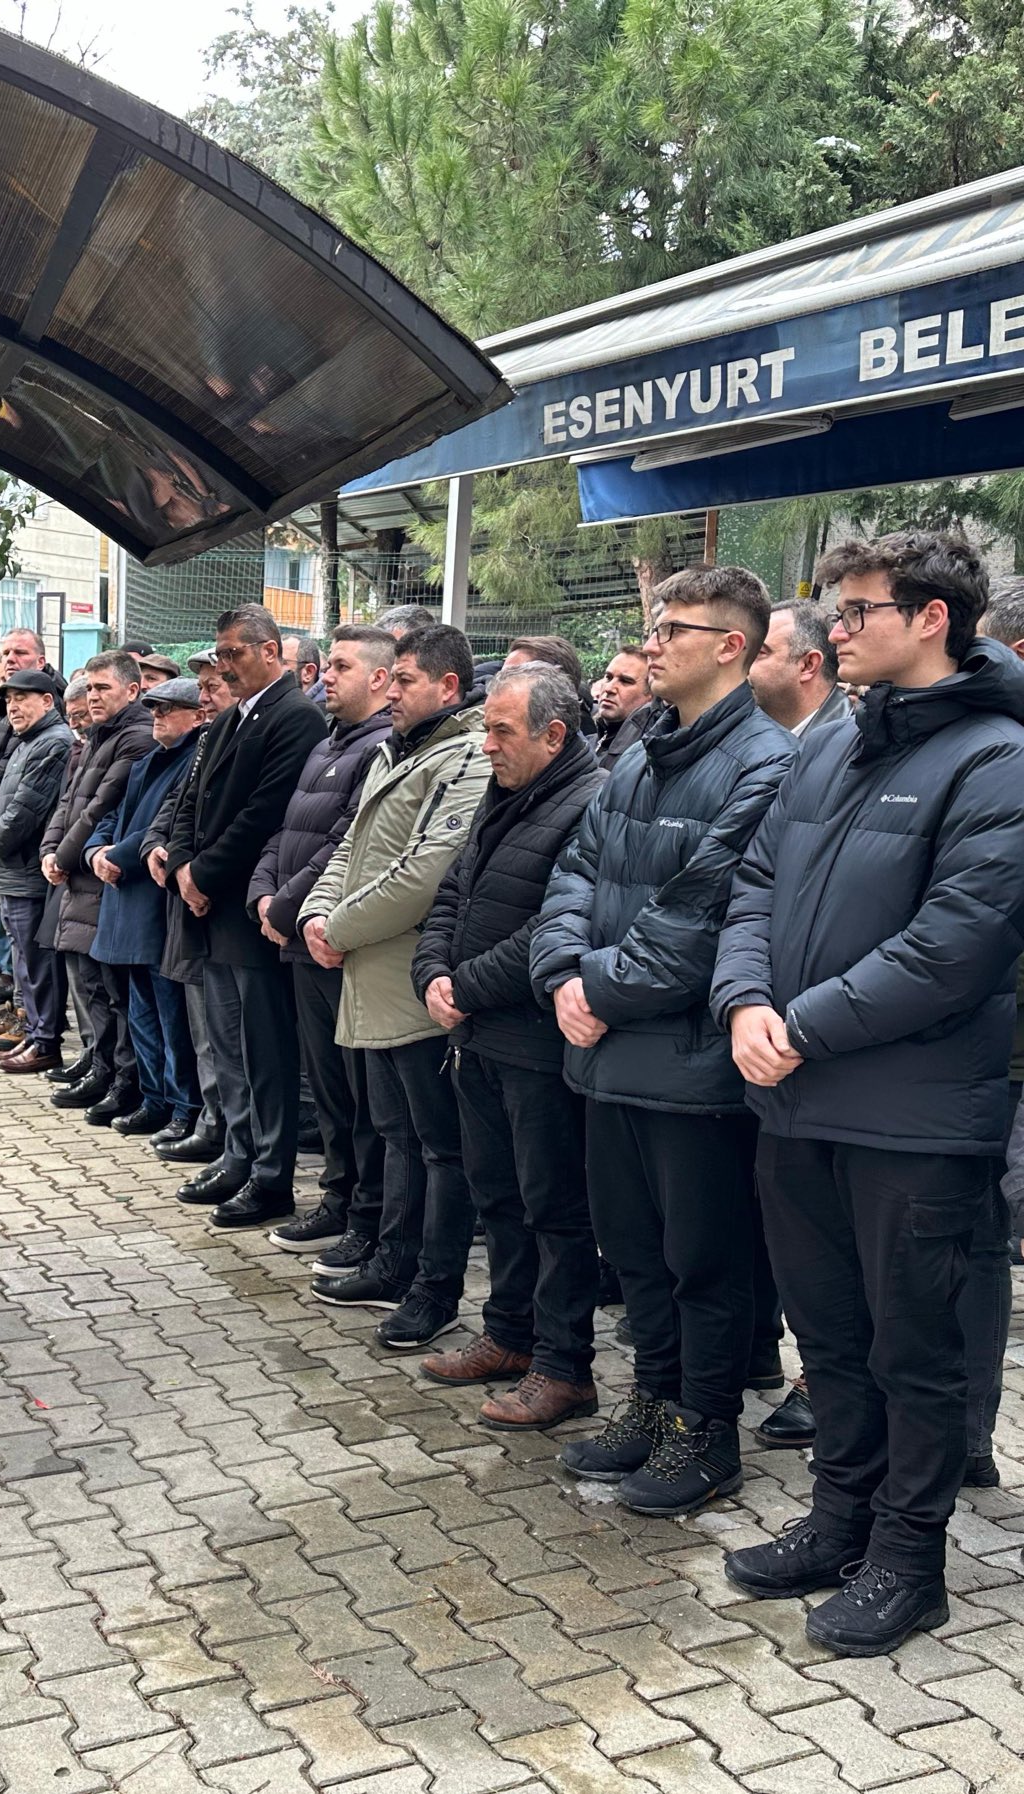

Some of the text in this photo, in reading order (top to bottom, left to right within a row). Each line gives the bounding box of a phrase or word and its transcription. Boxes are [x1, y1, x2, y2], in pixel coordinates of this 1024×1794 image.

[543, 294, 1024, 445] ESENYURT BELE
[887, 794, 918, 803] Columbia
[881, 1588, 907, 1615] Columbia
